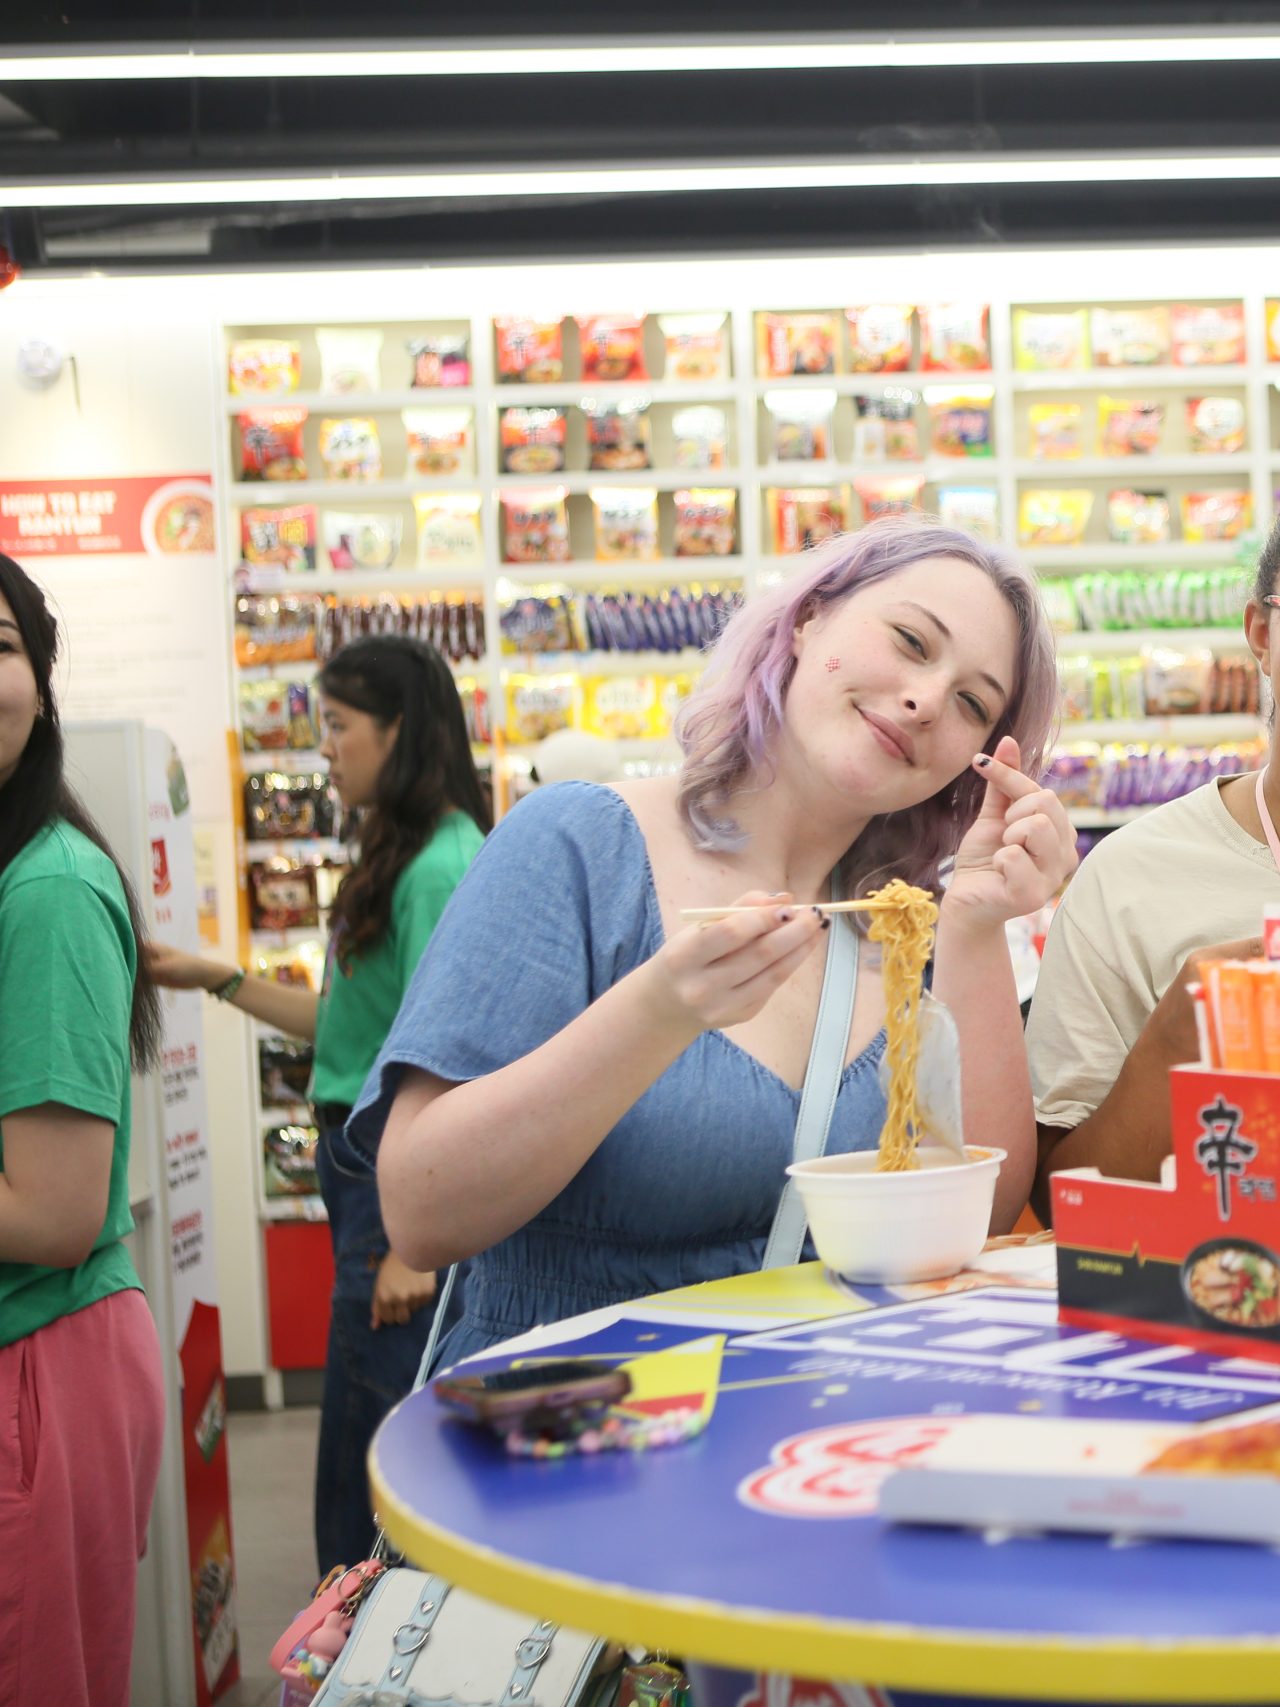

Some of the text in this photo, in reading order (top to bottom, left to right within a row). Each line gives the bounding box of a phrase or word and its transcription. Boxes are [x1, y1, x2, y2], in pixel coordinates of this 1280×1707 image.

[48, 492, 77, 514] TO
[78, 490, 116, 514] EAT
[1196, 1095, 1256, 1219] 辛
